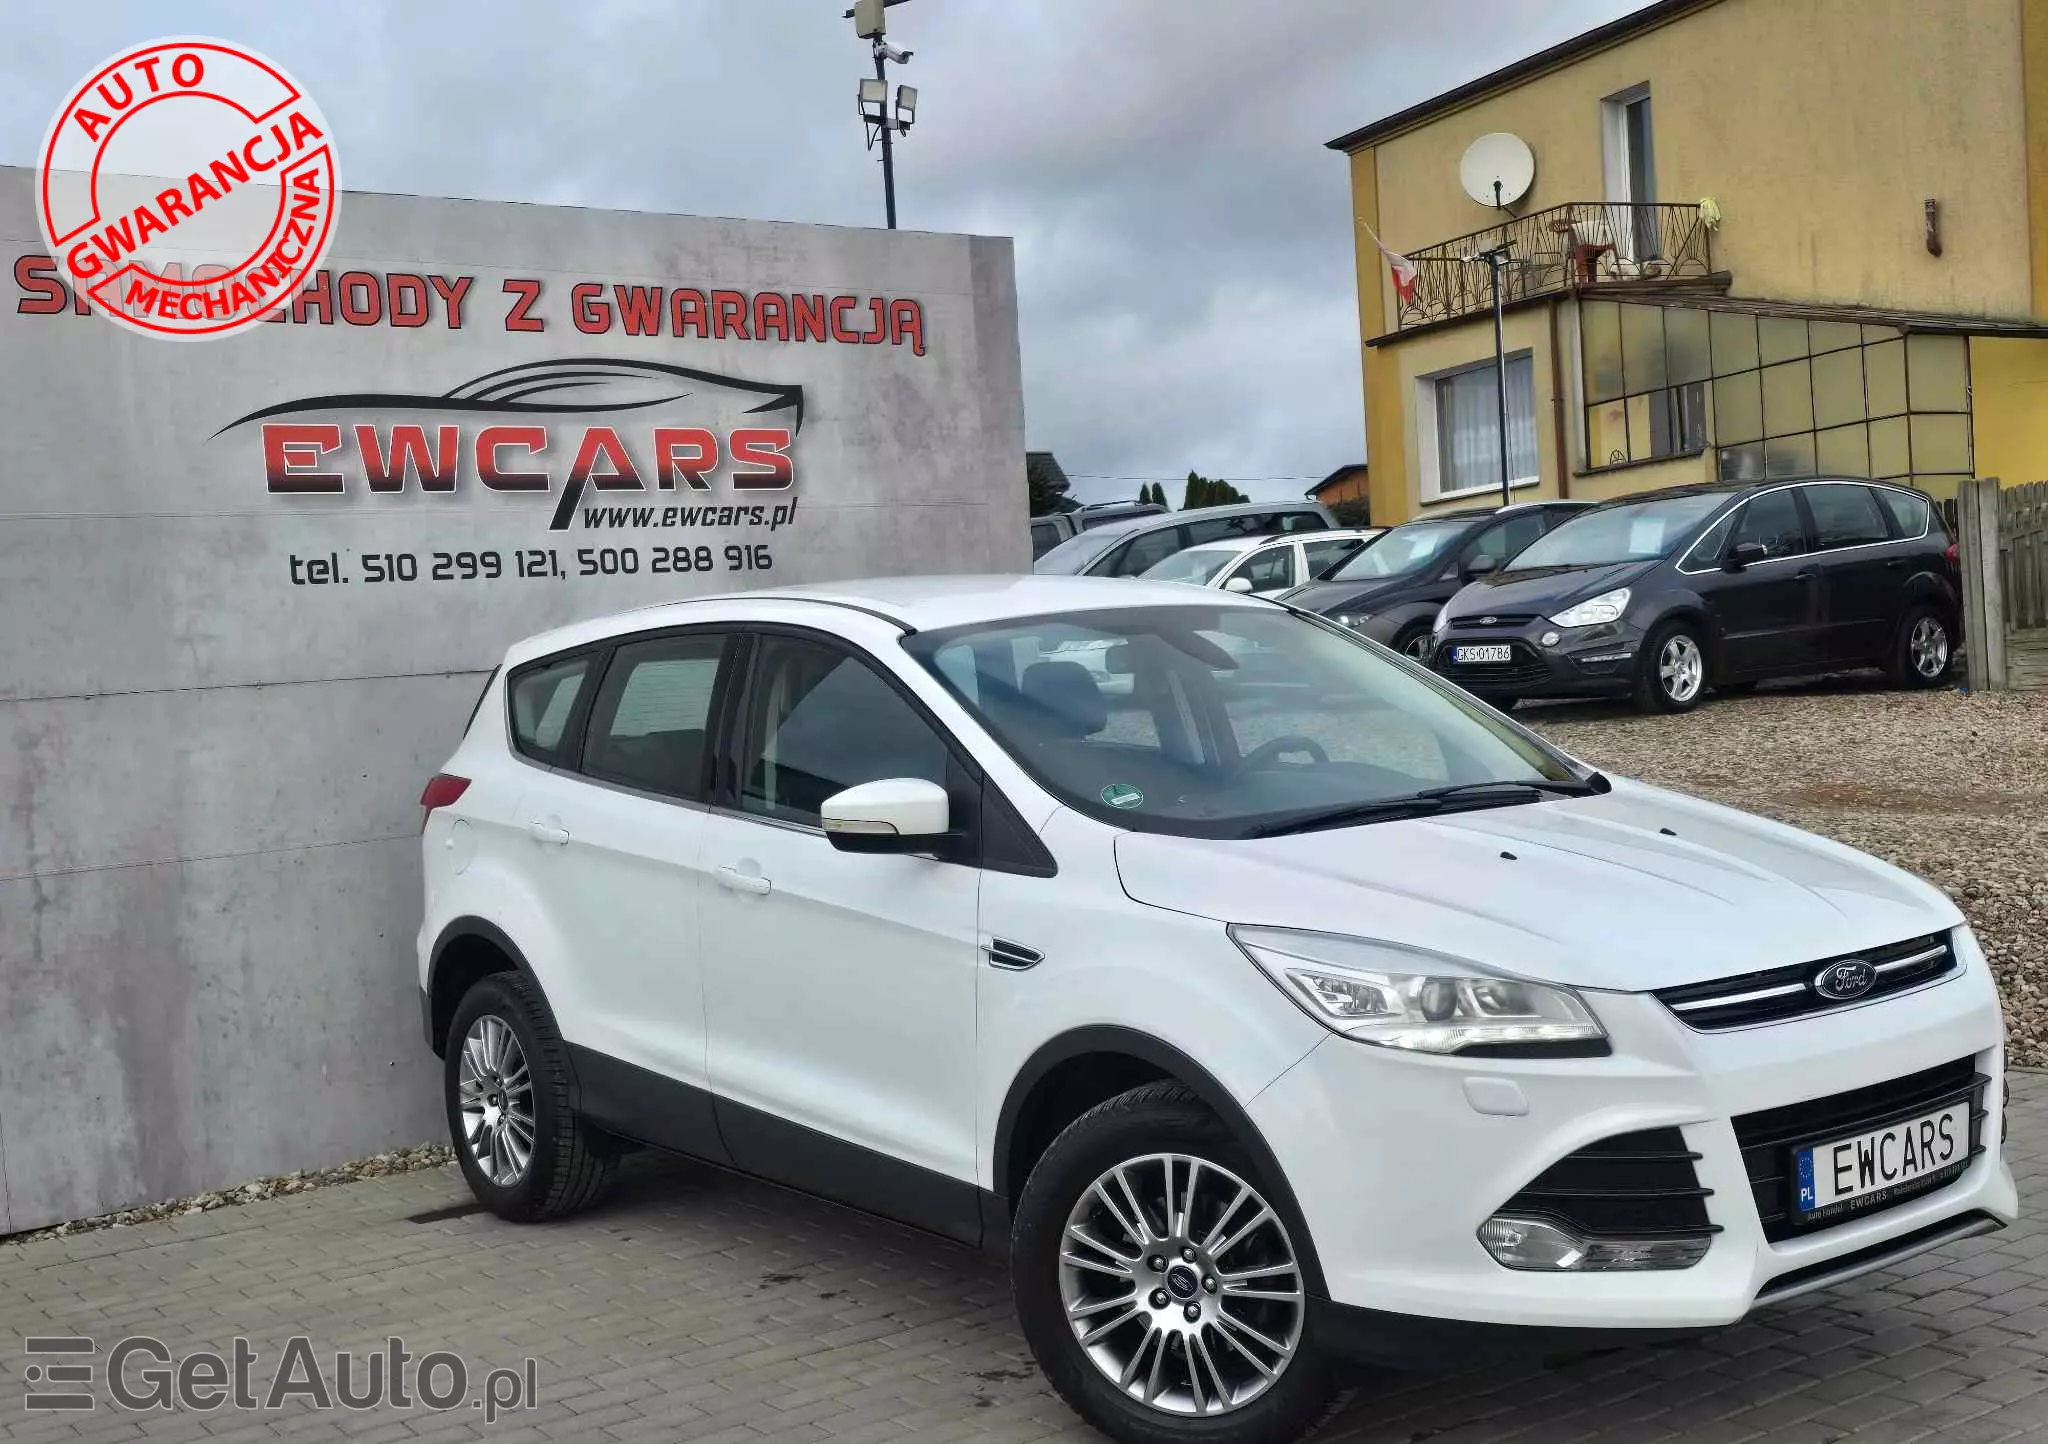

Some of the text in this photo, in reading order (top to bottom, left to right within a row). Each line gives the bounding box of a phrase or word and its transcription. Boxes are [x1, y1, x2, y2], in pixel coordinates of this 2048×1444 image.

[502, 279, 546, 332] Z
[571, 282, 926, 357] GWARANCJĄ
[261, 423, 794, 532] EWCARS
[584, 497, 799, 532] www.ewcars.pl
[289, 544, 773, 586] tel. 510 299 121, 500 288 916
[1835, 965, 1868, 992] Ford
[1833, 1113, 1955, 1197] EWCARS
[1801, 1187, 1813, 1202] PL
[1850, 1191, 1888, 1209] EWCARS
